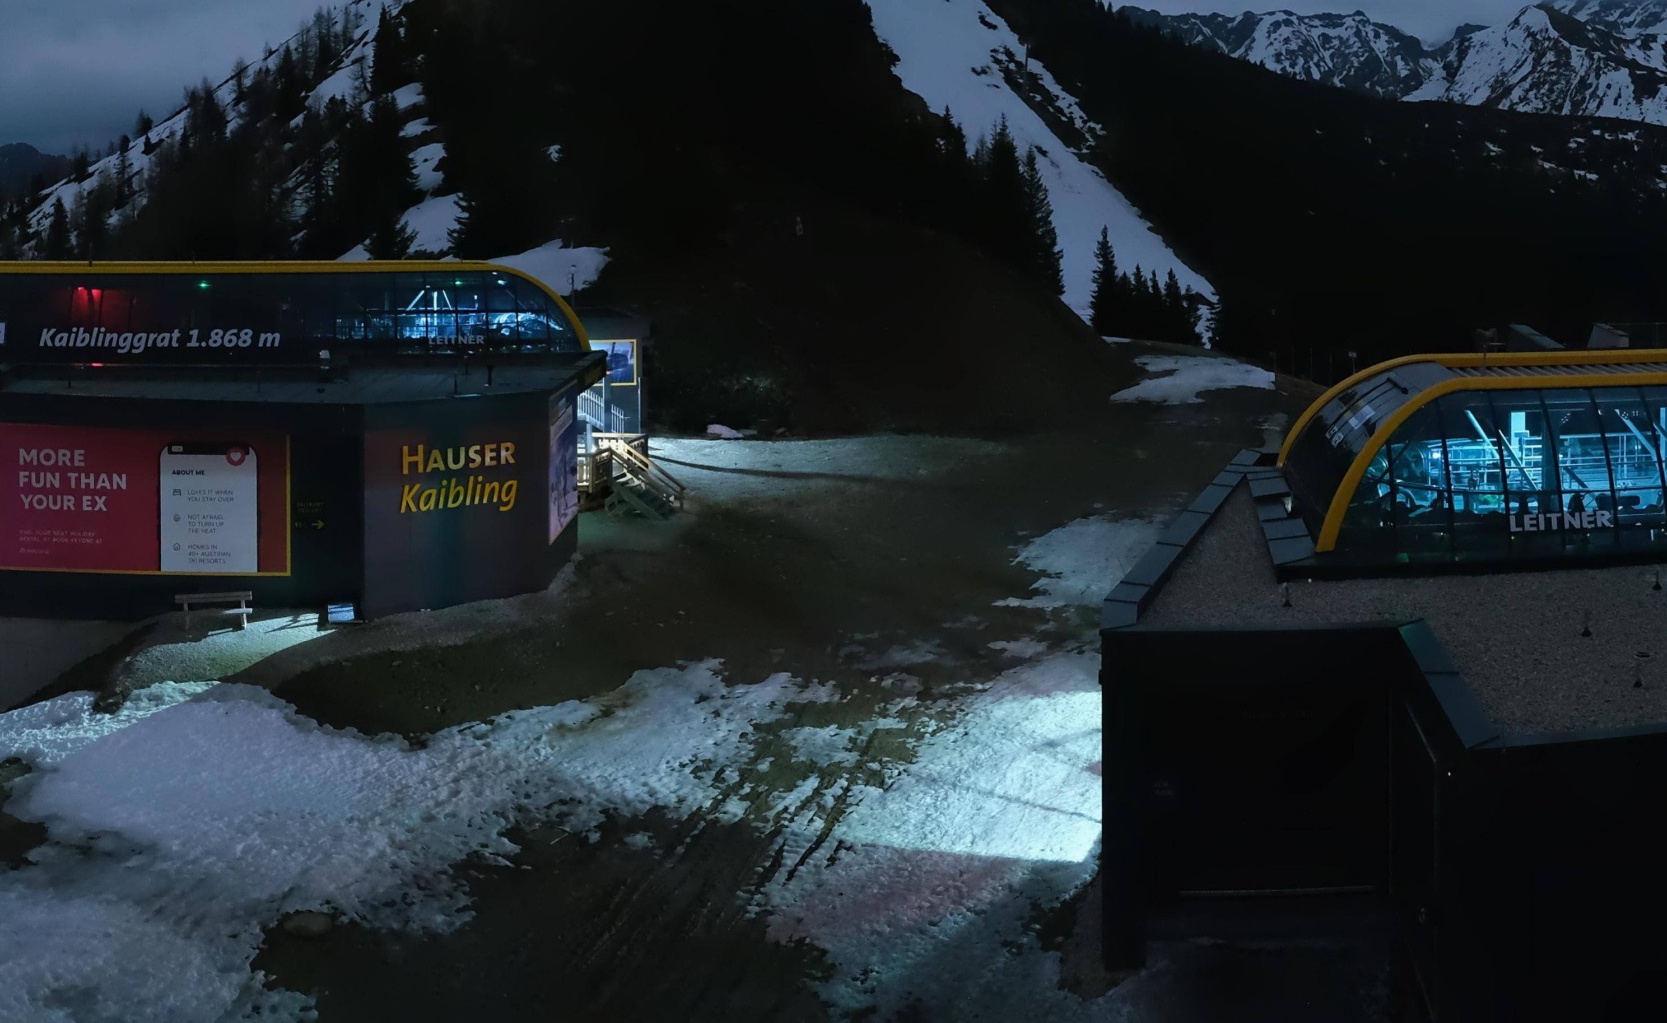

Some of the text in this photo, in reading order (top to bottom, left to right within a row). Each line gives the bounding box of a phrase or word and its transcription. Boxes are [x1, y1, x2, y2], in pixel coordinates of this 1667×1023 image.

[39, 327, 281, 354] Kaiblinggrat 1.868 m
[428, 335, 485, 345] LEITNER
[18, 448, 86, 467] MORE
[401, 441, 516, 475] HAUSER
[18, 471, 127, 490] FUN THAN
[20, 493, 108, 512] YOUR EX
[399, 475, 518, 515] Kaibling
[1508, 509, 1614, 533] LEITNER
